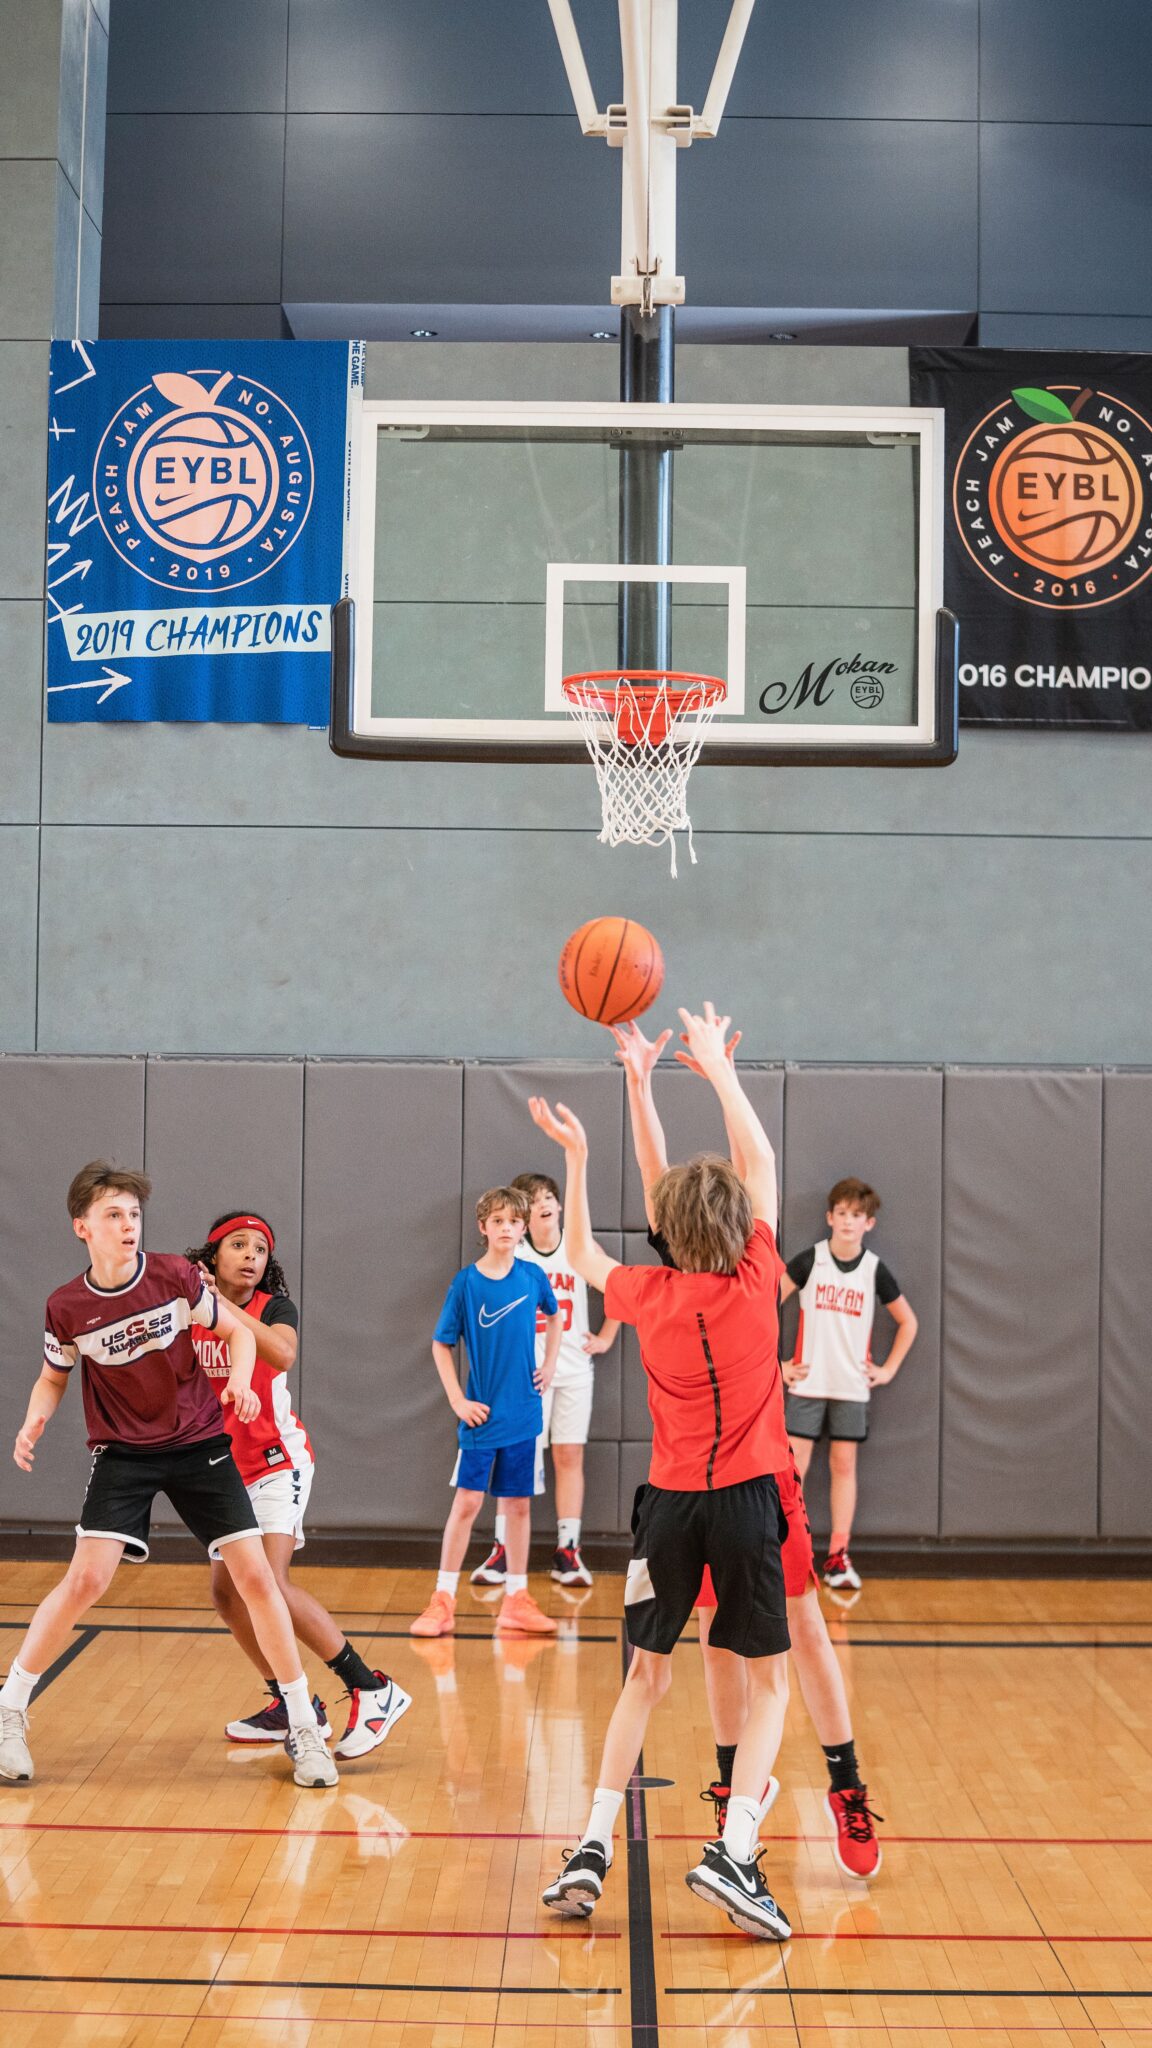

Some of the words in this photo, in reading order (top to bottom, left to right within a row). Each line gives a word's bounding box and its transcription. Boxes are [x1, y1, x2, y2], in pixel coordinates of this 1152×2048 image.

[115, 401, 154, 449] JAM
[976, 416, 1015, 463] JAM
[1098, 405, 1136, 443] NO.
[155, 456, 257, 485] EYBL
[238, 389, 274, 425] NO.
[260, 434, 303, 553] AUGUSTA
[1017, 471, 1120, 502] EYBL
[105, 463, 140, 551] PEACH
[965, 479, 1004, 567] PEACH
[168, 563, 231, 582] 2019
[1033, 579, 1097, 597] 2016
[74, 618, 136, 656] 2019
[145, 609, 323, 654] CHAMPIONS
[759, 653, 899, 714] Mokan
[855, 686, 881, 694] EYBL
[958, 663, 1007, 688] 016
[1014, 663, 1152, 690] CHAMPIO
[816, 1284, 865, 1309] MOKAN
